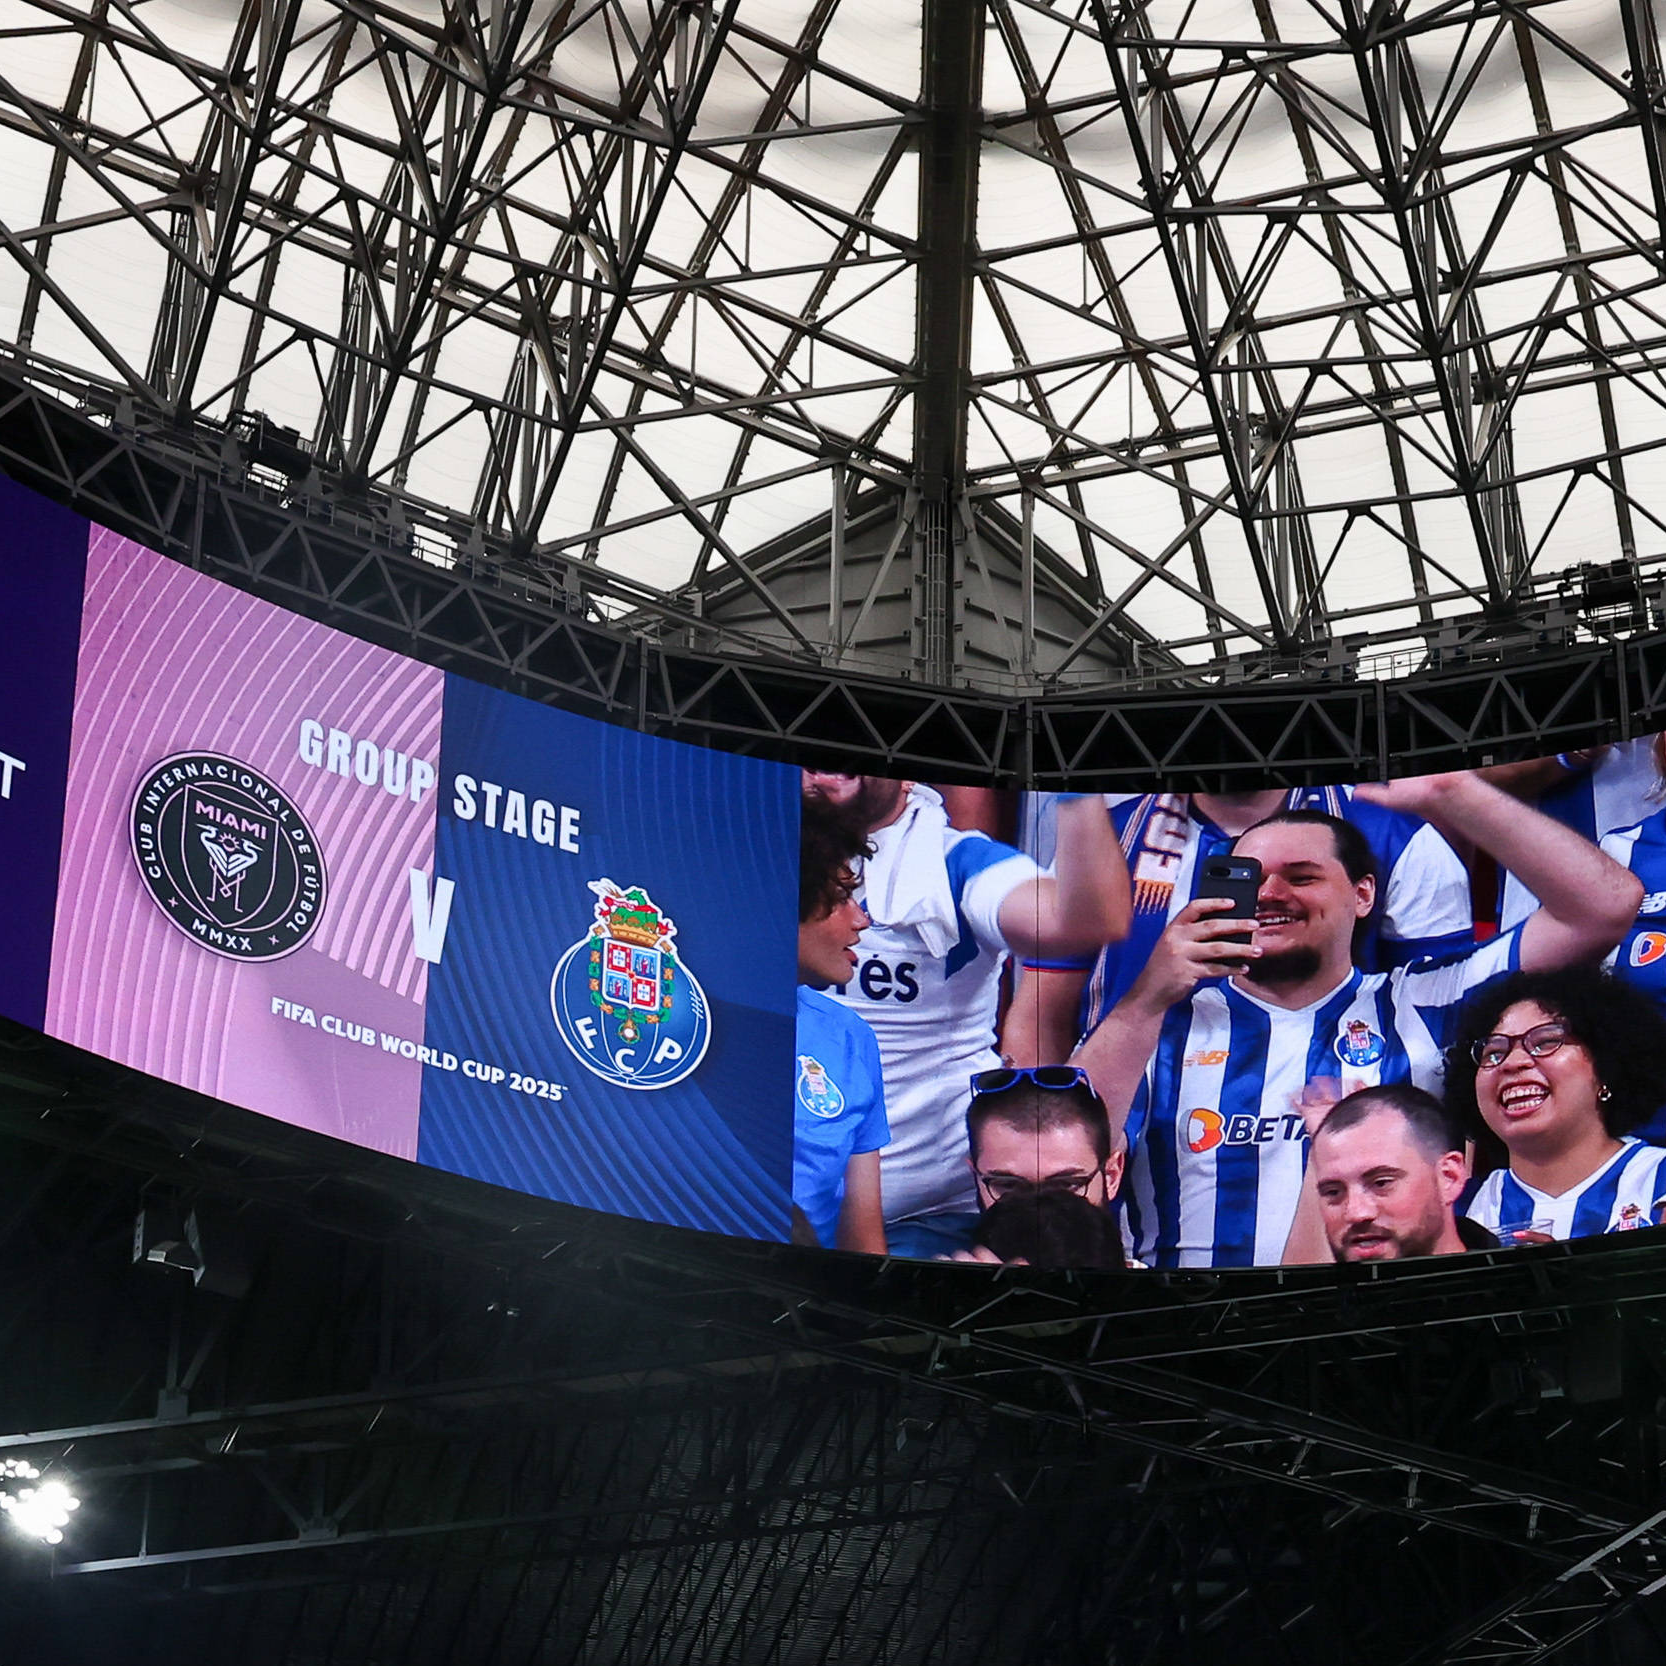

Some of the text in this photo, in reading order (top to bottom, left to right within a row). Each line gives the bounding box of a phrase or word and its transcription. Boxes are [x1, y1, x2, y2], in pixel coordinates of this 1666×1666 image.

[195, 799, 268, 841] MIAMI
[298, 718, 582, 854] GROUP STAGE
[140, 762, 321, 933] CLUB INTERNACIONAL DE FÚTBOL
[192, 918, 253, 951] MMXX
[409, 867, 455, 965] V
[270, 996, 317, 1029] FIFA
[320, 1014, 377, 1047] CLUB
[379, 1031, 459, 1072] WORLD
[461, 1058, 506, 1085] CUP
